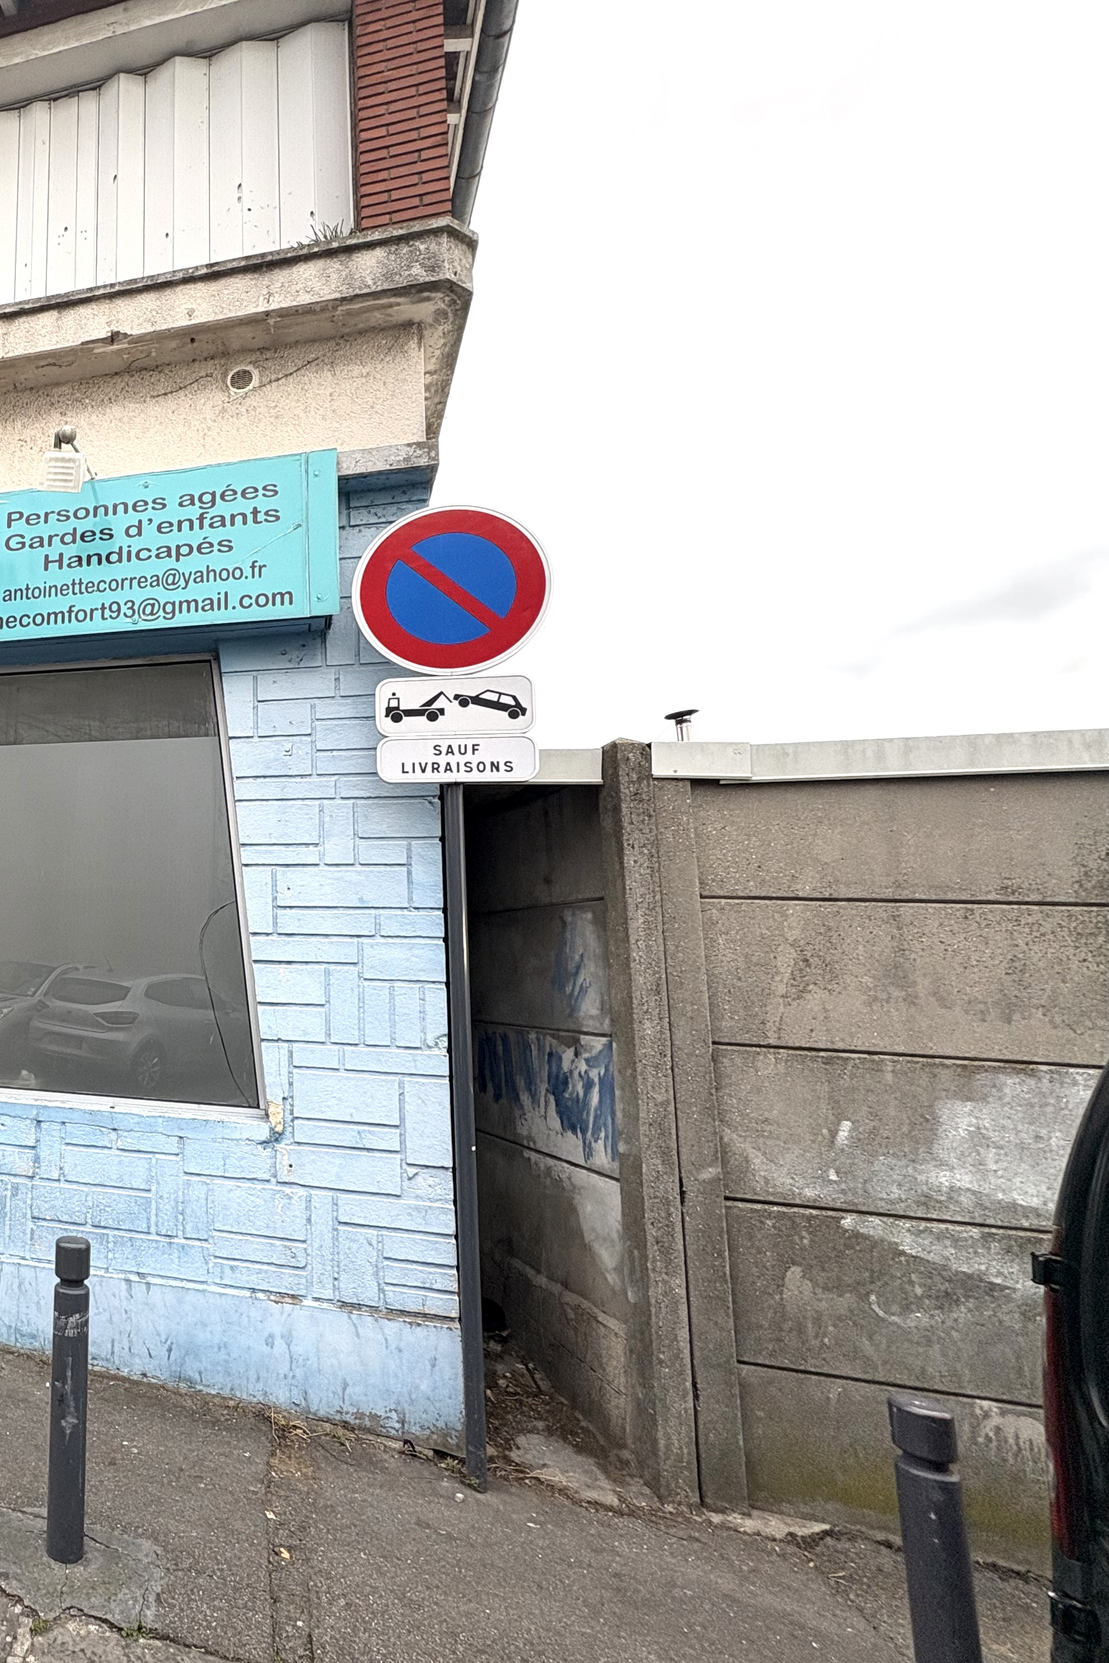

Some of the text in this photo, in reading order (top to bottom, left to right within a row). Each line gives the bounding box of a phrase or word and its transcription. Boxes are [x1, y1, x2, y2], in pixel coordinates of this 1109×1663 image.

[6, 482, 280, 529] Personnes agées
[4, 504, 282, 552] Gardes d’enfants
[43, 537, 234, 572] Handicapés
[401, 760, 514, 774] LIVRAISONS
[432, 743, 481, 756] SAUF
